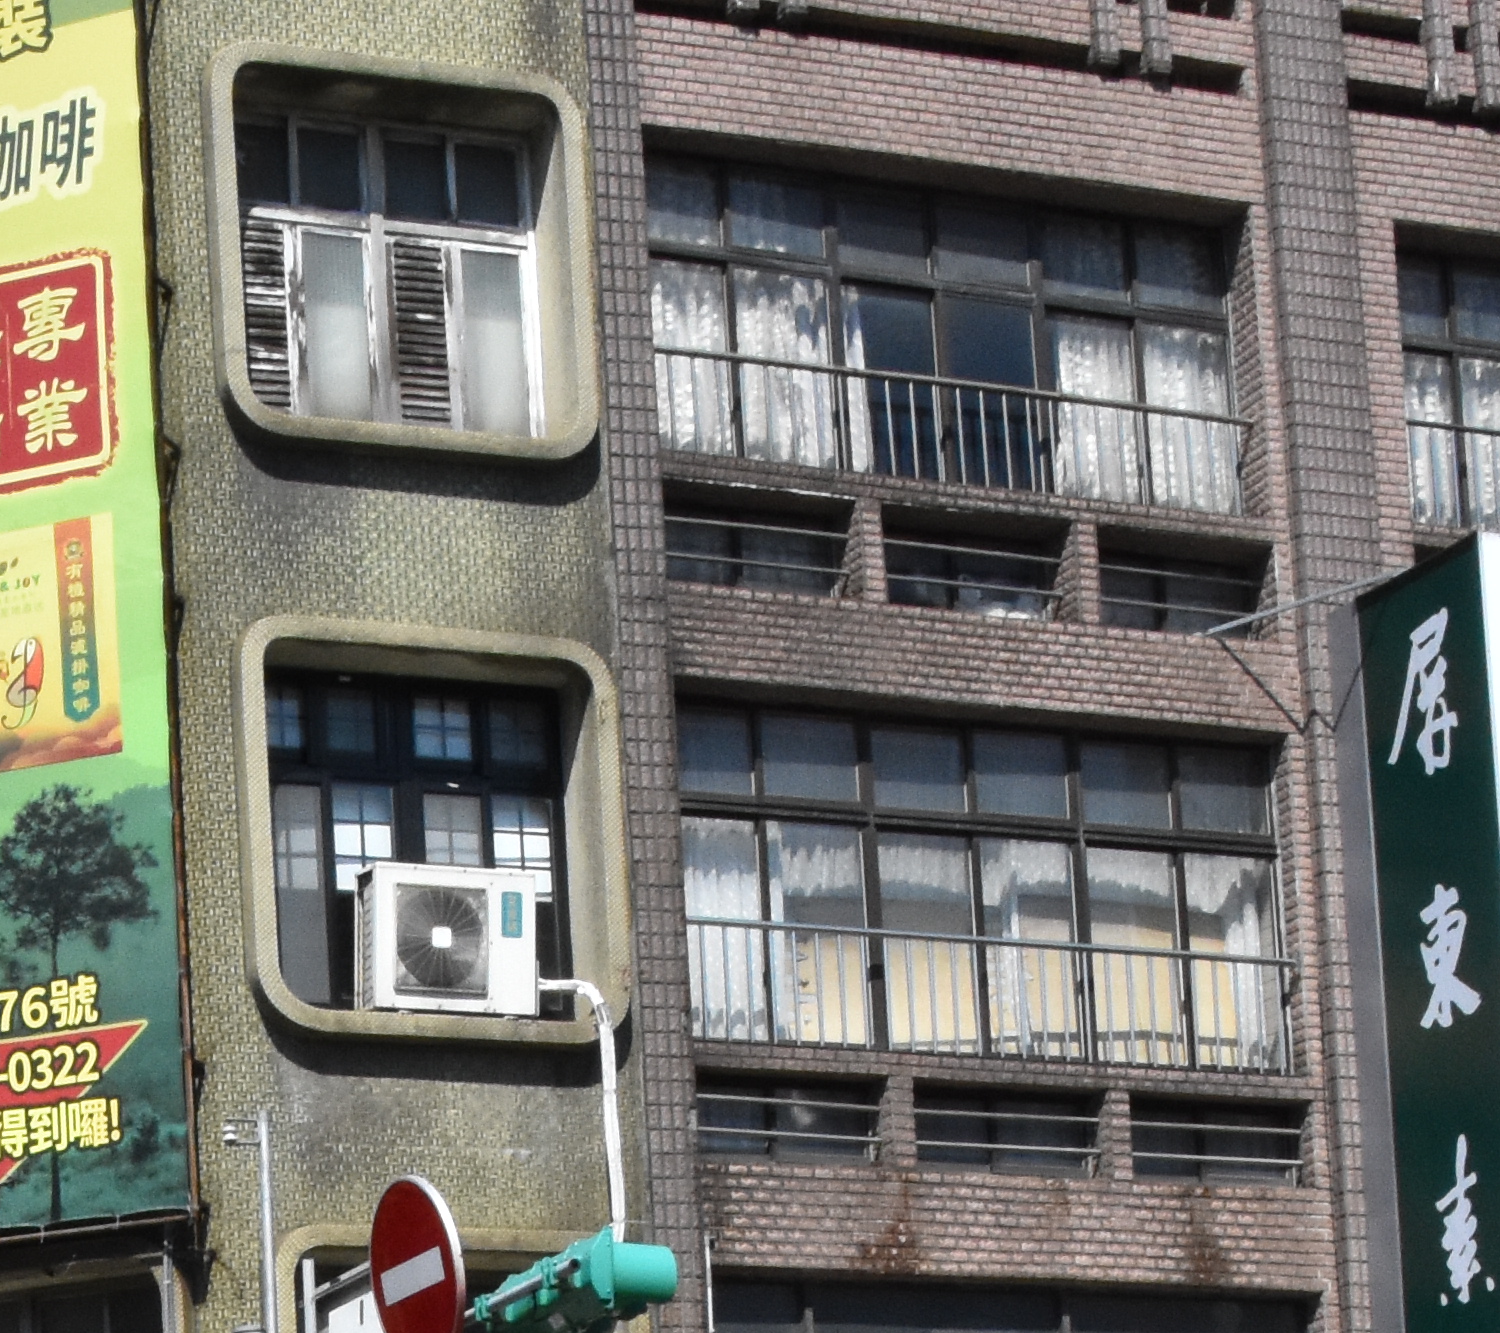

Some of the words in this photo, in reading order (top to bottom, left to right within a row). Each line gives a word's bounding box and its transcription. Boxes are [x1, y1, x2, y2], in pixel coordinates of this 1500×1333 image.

[12, 284, 88, 452] 專業
[0, 582, 9, 593] &
[15, 575, 40, 590] JOY
